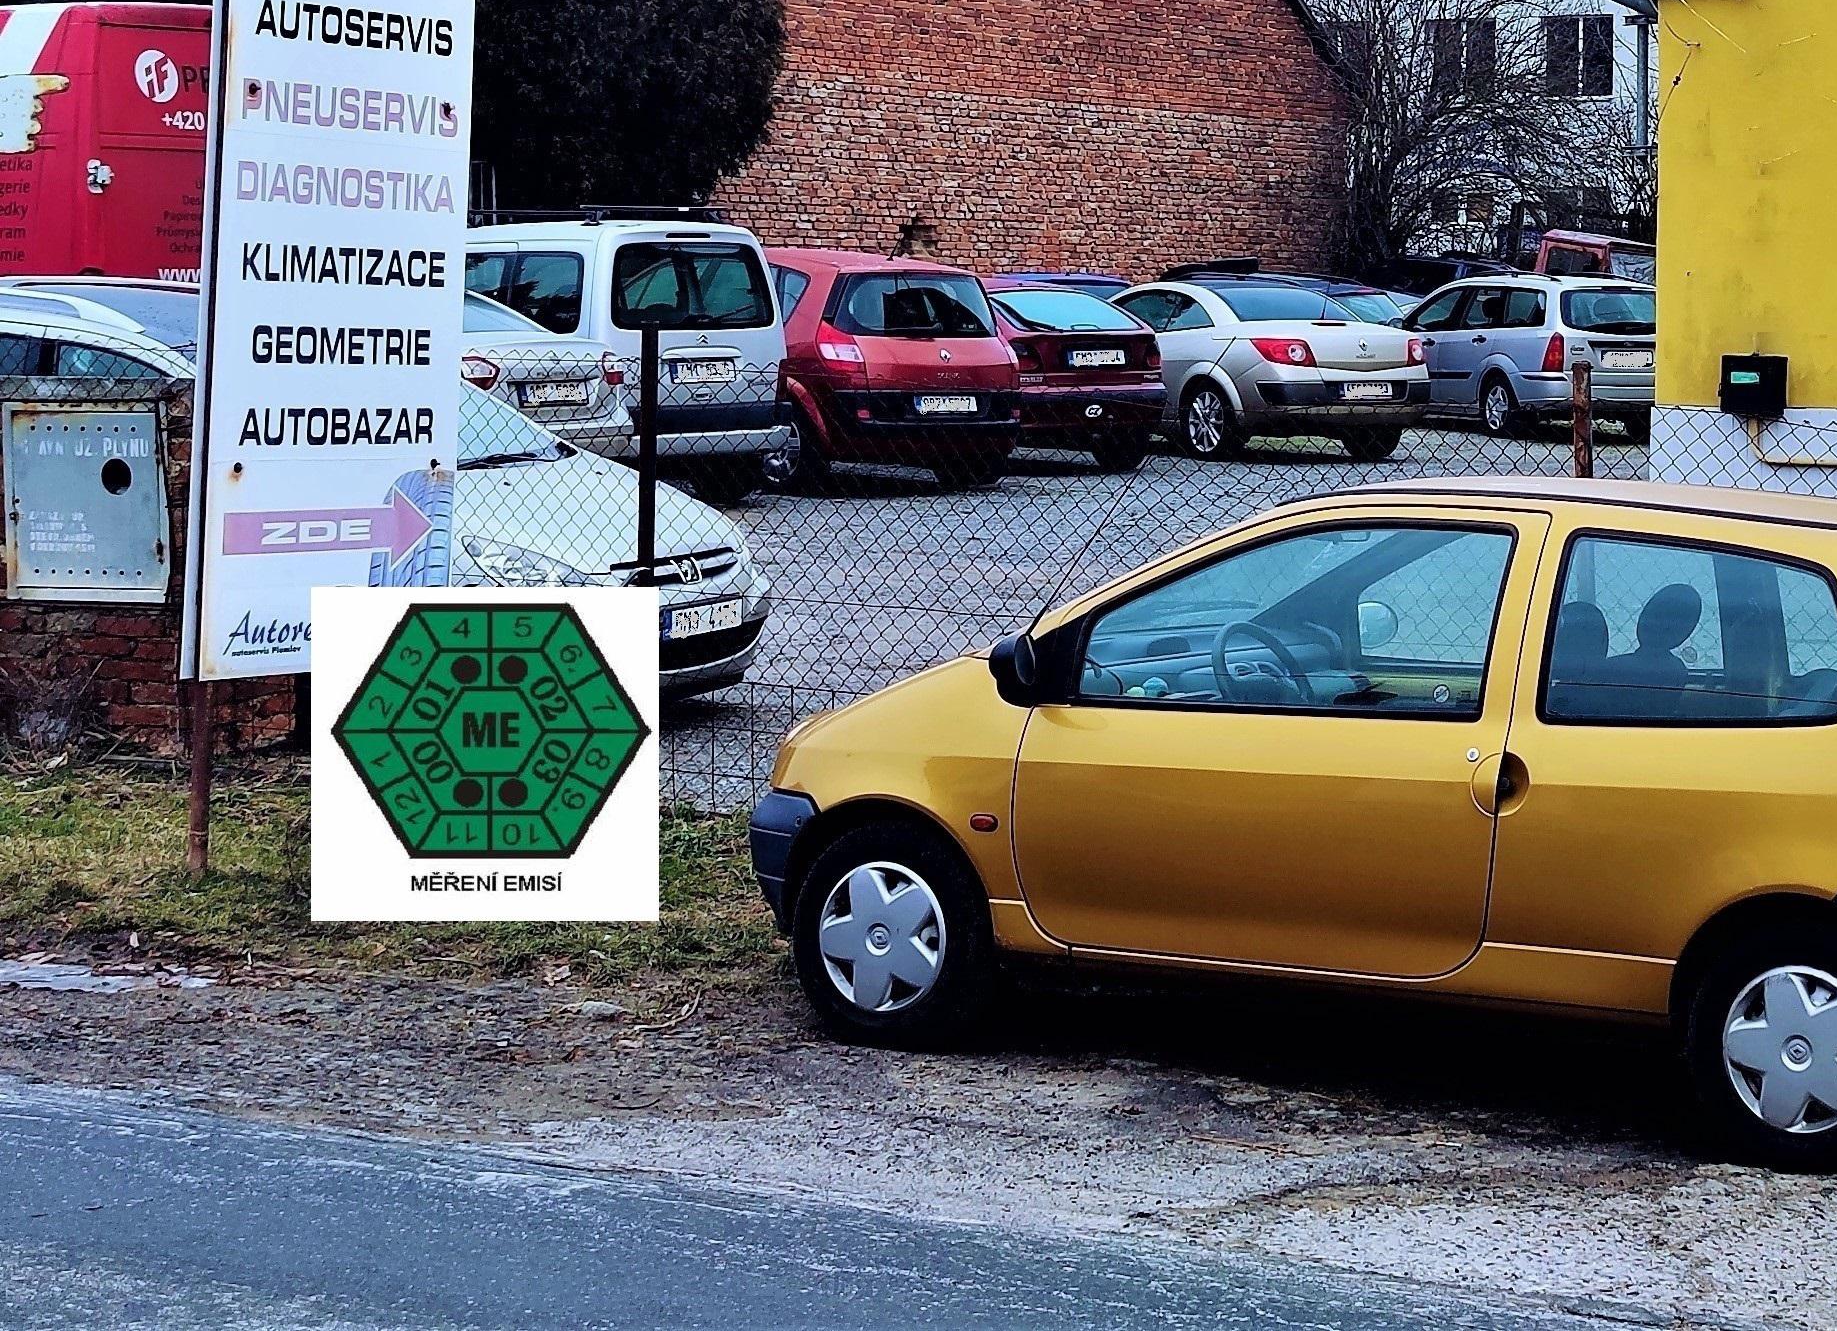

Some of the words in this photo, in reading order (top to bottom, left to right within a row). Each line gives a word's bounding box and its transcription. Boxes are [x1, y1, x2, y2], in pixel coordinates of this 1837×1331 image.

[161, 111, 205, 130] +420
[242, 78, 458, 138] PNEUSERVIS
[237, 161, 454, 214] DIAGNOSTIKA
[242, 243, 445, 288] KLIMATIZACE
[251, 326, 431, 366] GEOMETRIE
[239, 407, 434, 446] AUTOBAZAR
[261, 519, 372, 545] ZDE
